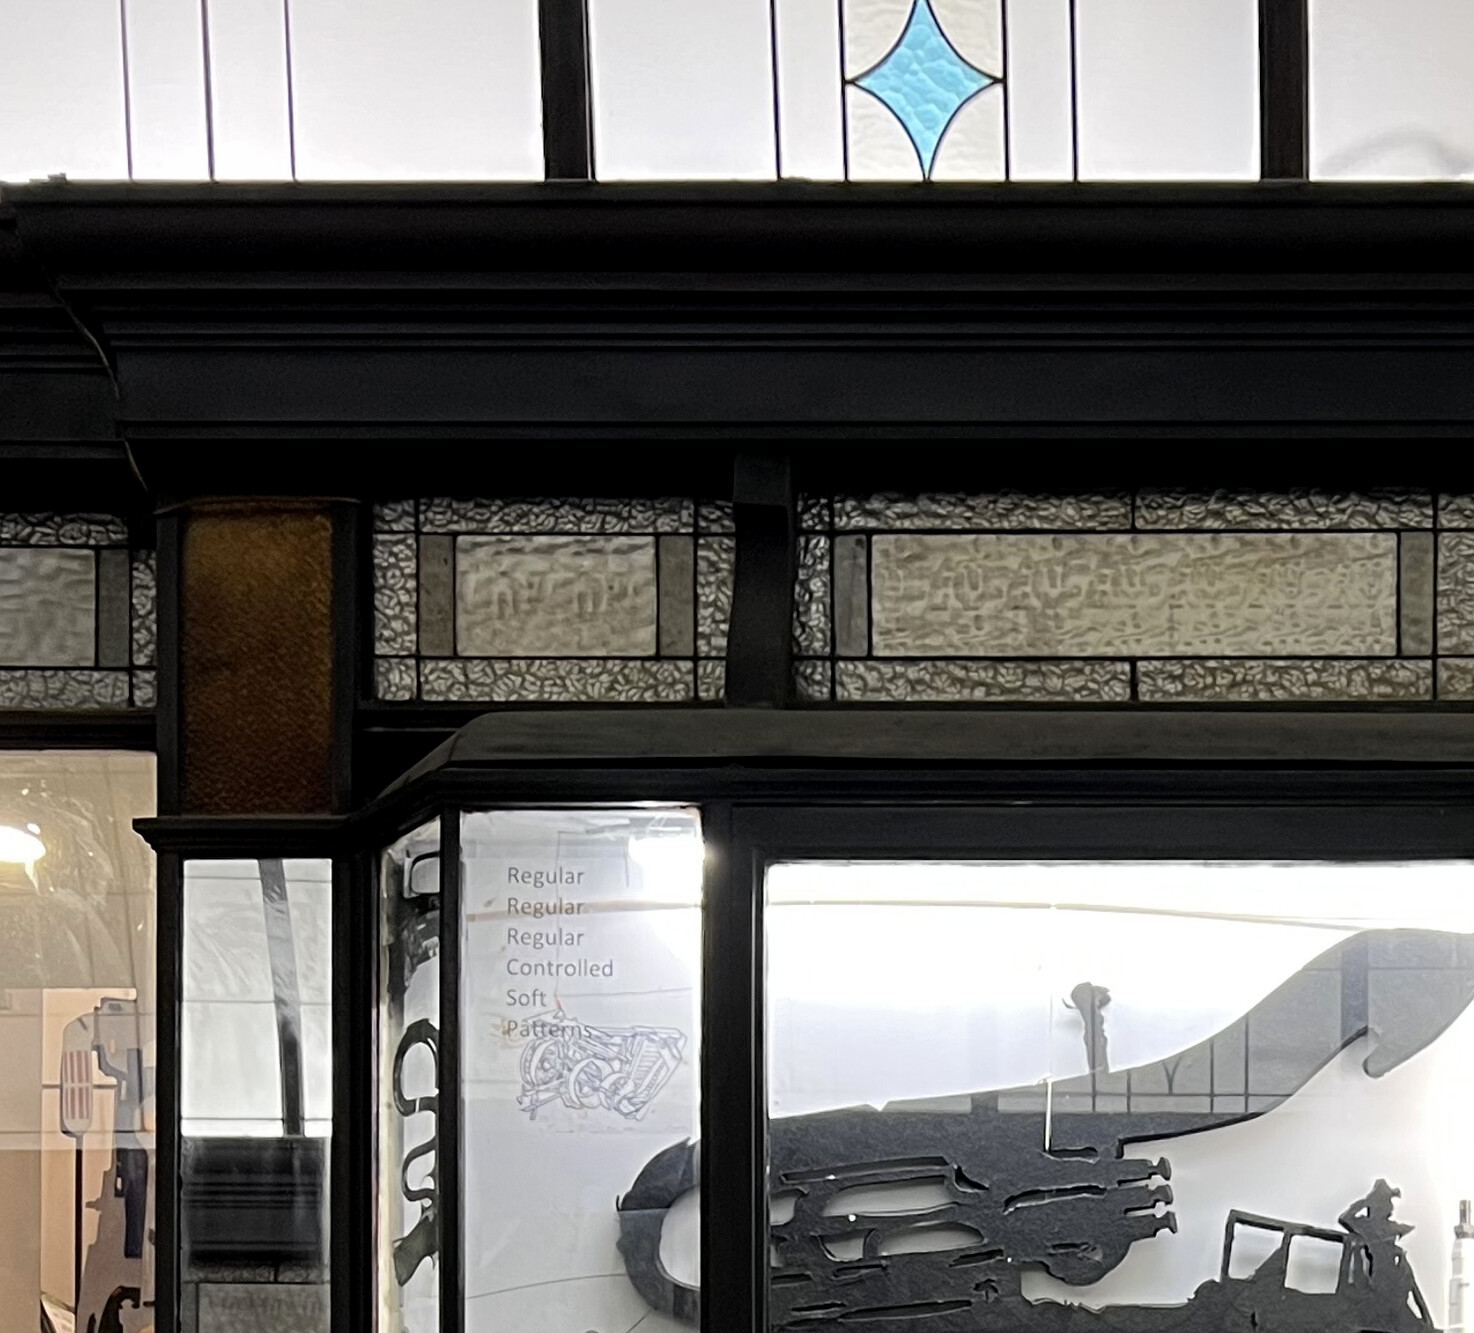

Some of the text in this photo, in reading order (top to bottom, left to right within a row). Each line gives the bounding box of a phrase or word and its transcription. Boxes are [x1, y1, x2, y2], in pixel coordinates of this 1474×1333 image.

[507, 866, 585, 889] Regular
[507, 897, 585, 919] Regular
[507, 927, 585, 950] Regular
[506, 957, 614, 978] Controlled
[506, 987, 547, 1007] Soft
[507, 1019, 593, 1038] Patterns
